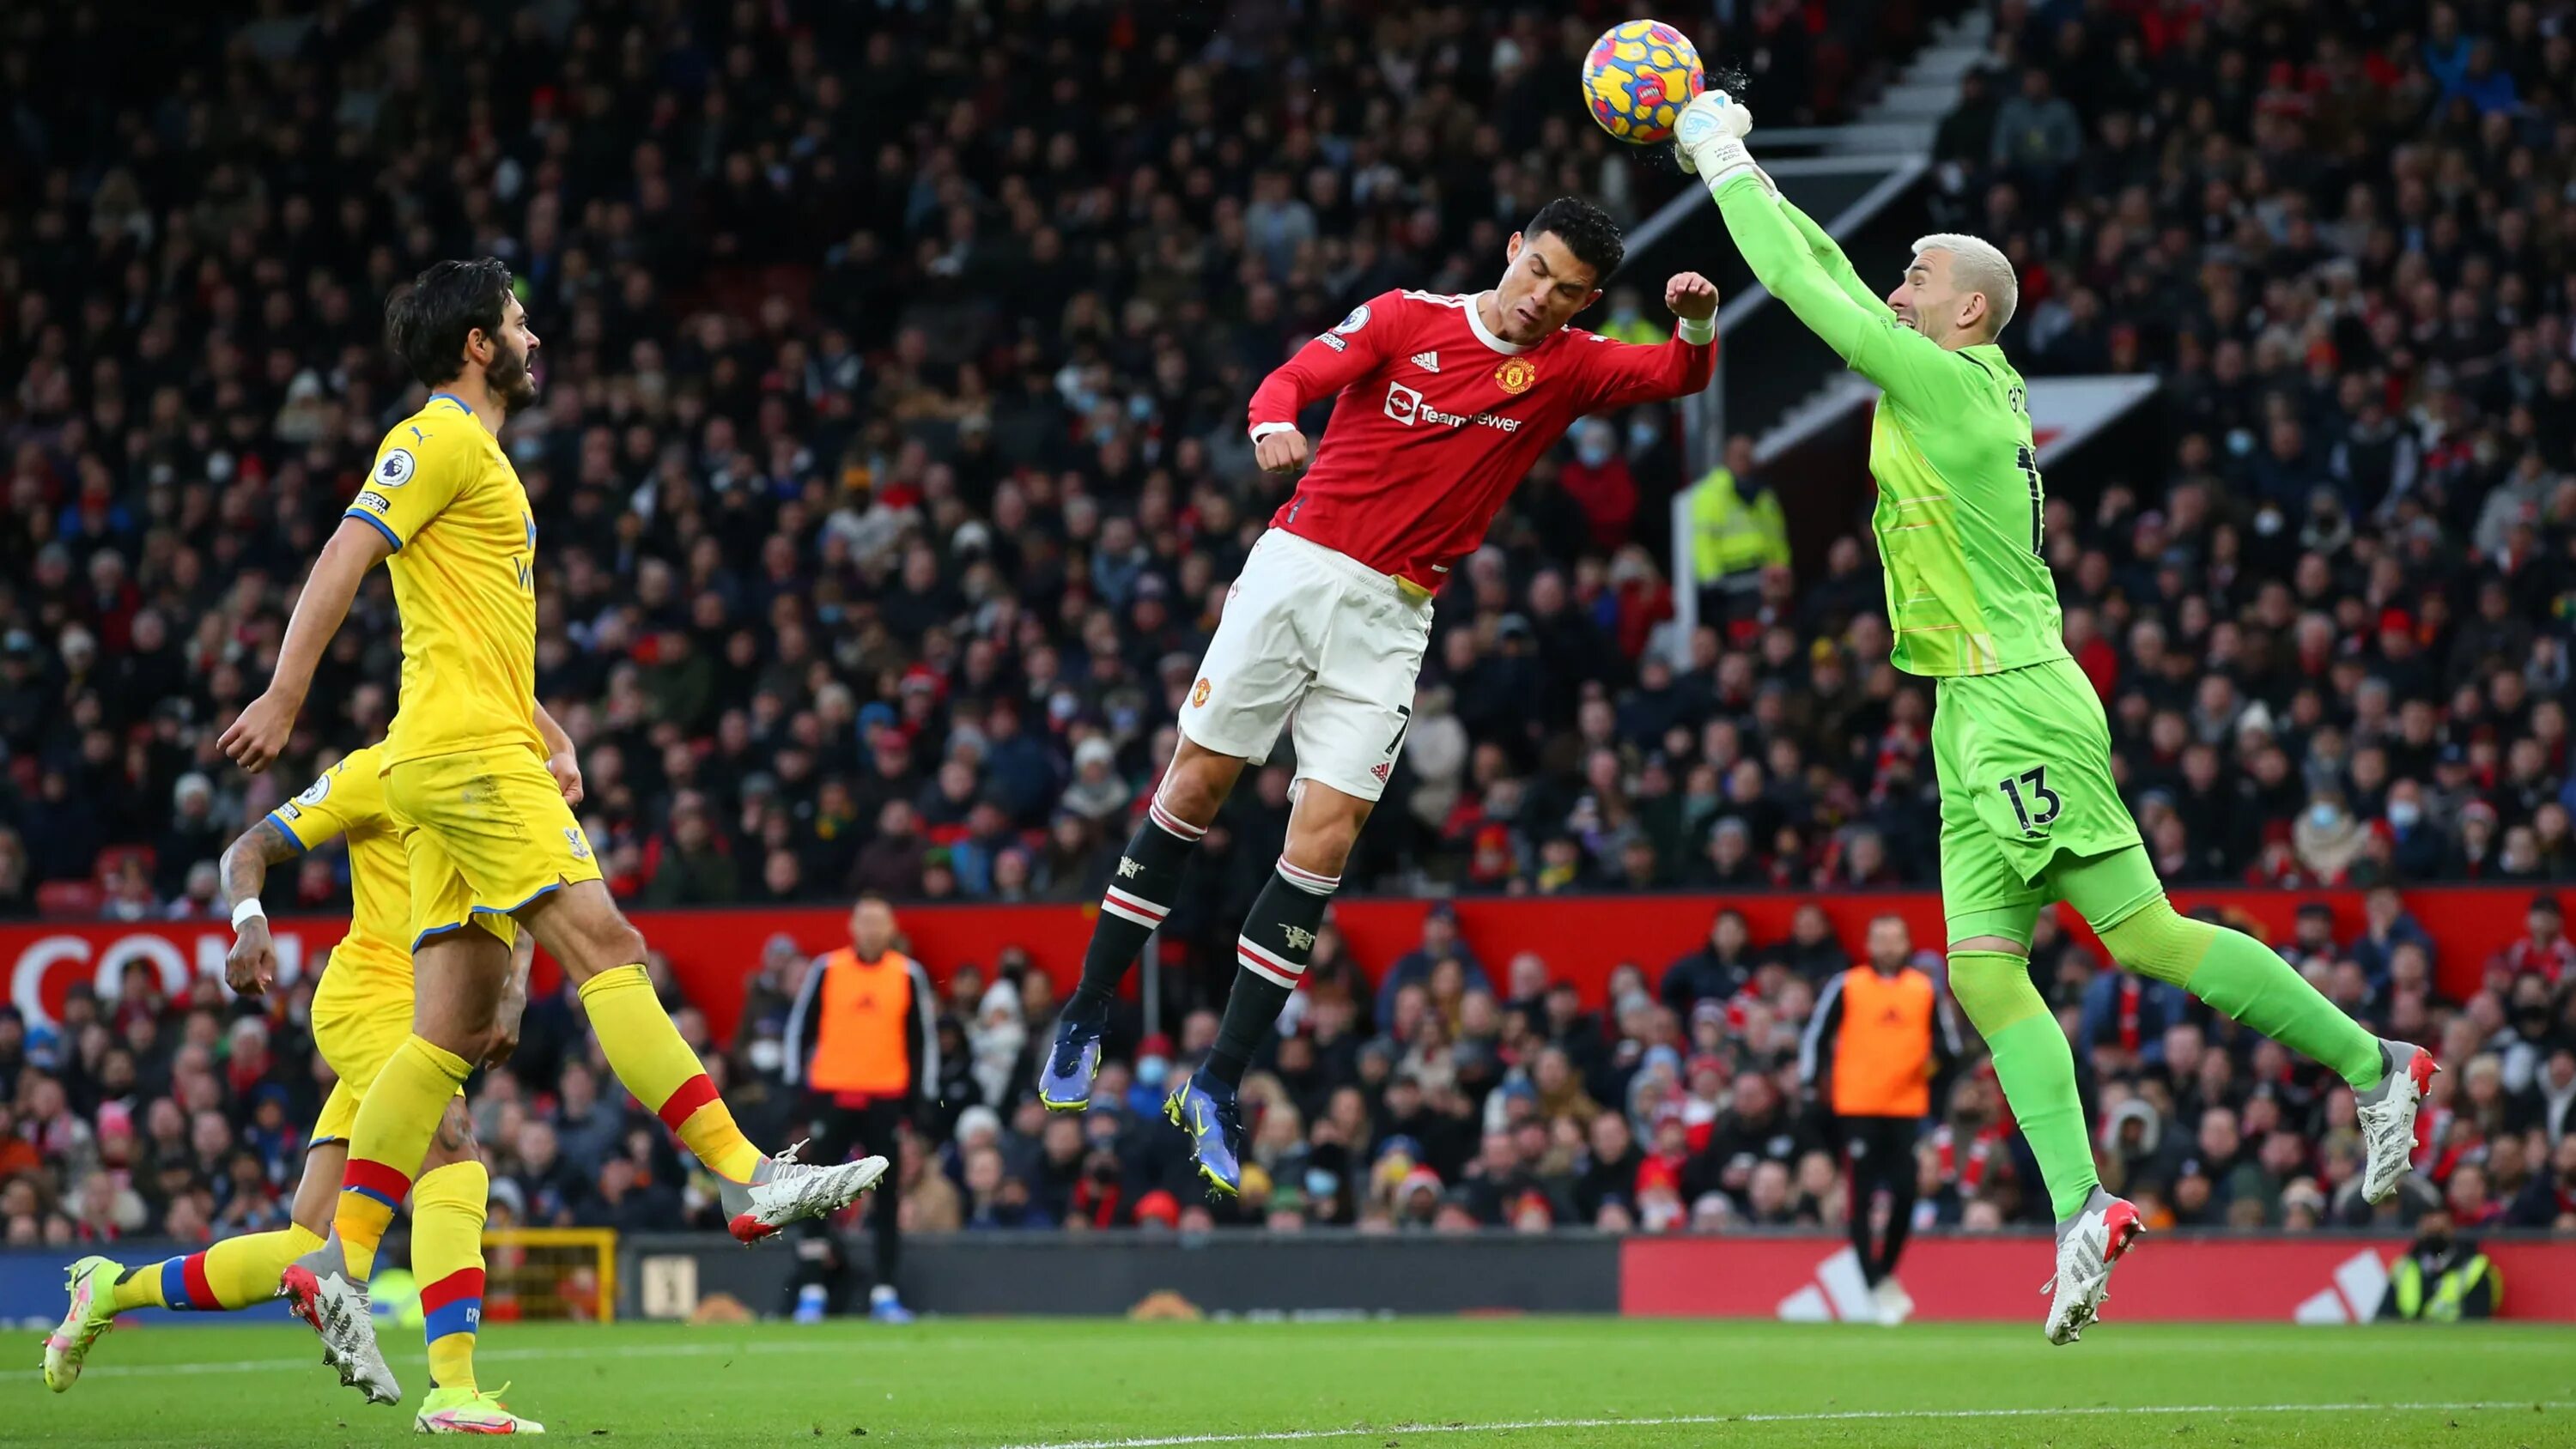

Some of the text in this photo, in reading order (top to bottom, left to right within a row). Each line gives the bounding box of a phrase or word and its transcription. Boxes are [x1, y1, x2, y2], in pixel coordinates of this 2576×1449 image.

[1411, 355, 1440, 373] adidas
[1384, 704, 1412, 756] 7
[1998, 762, 2061, 832] 13
